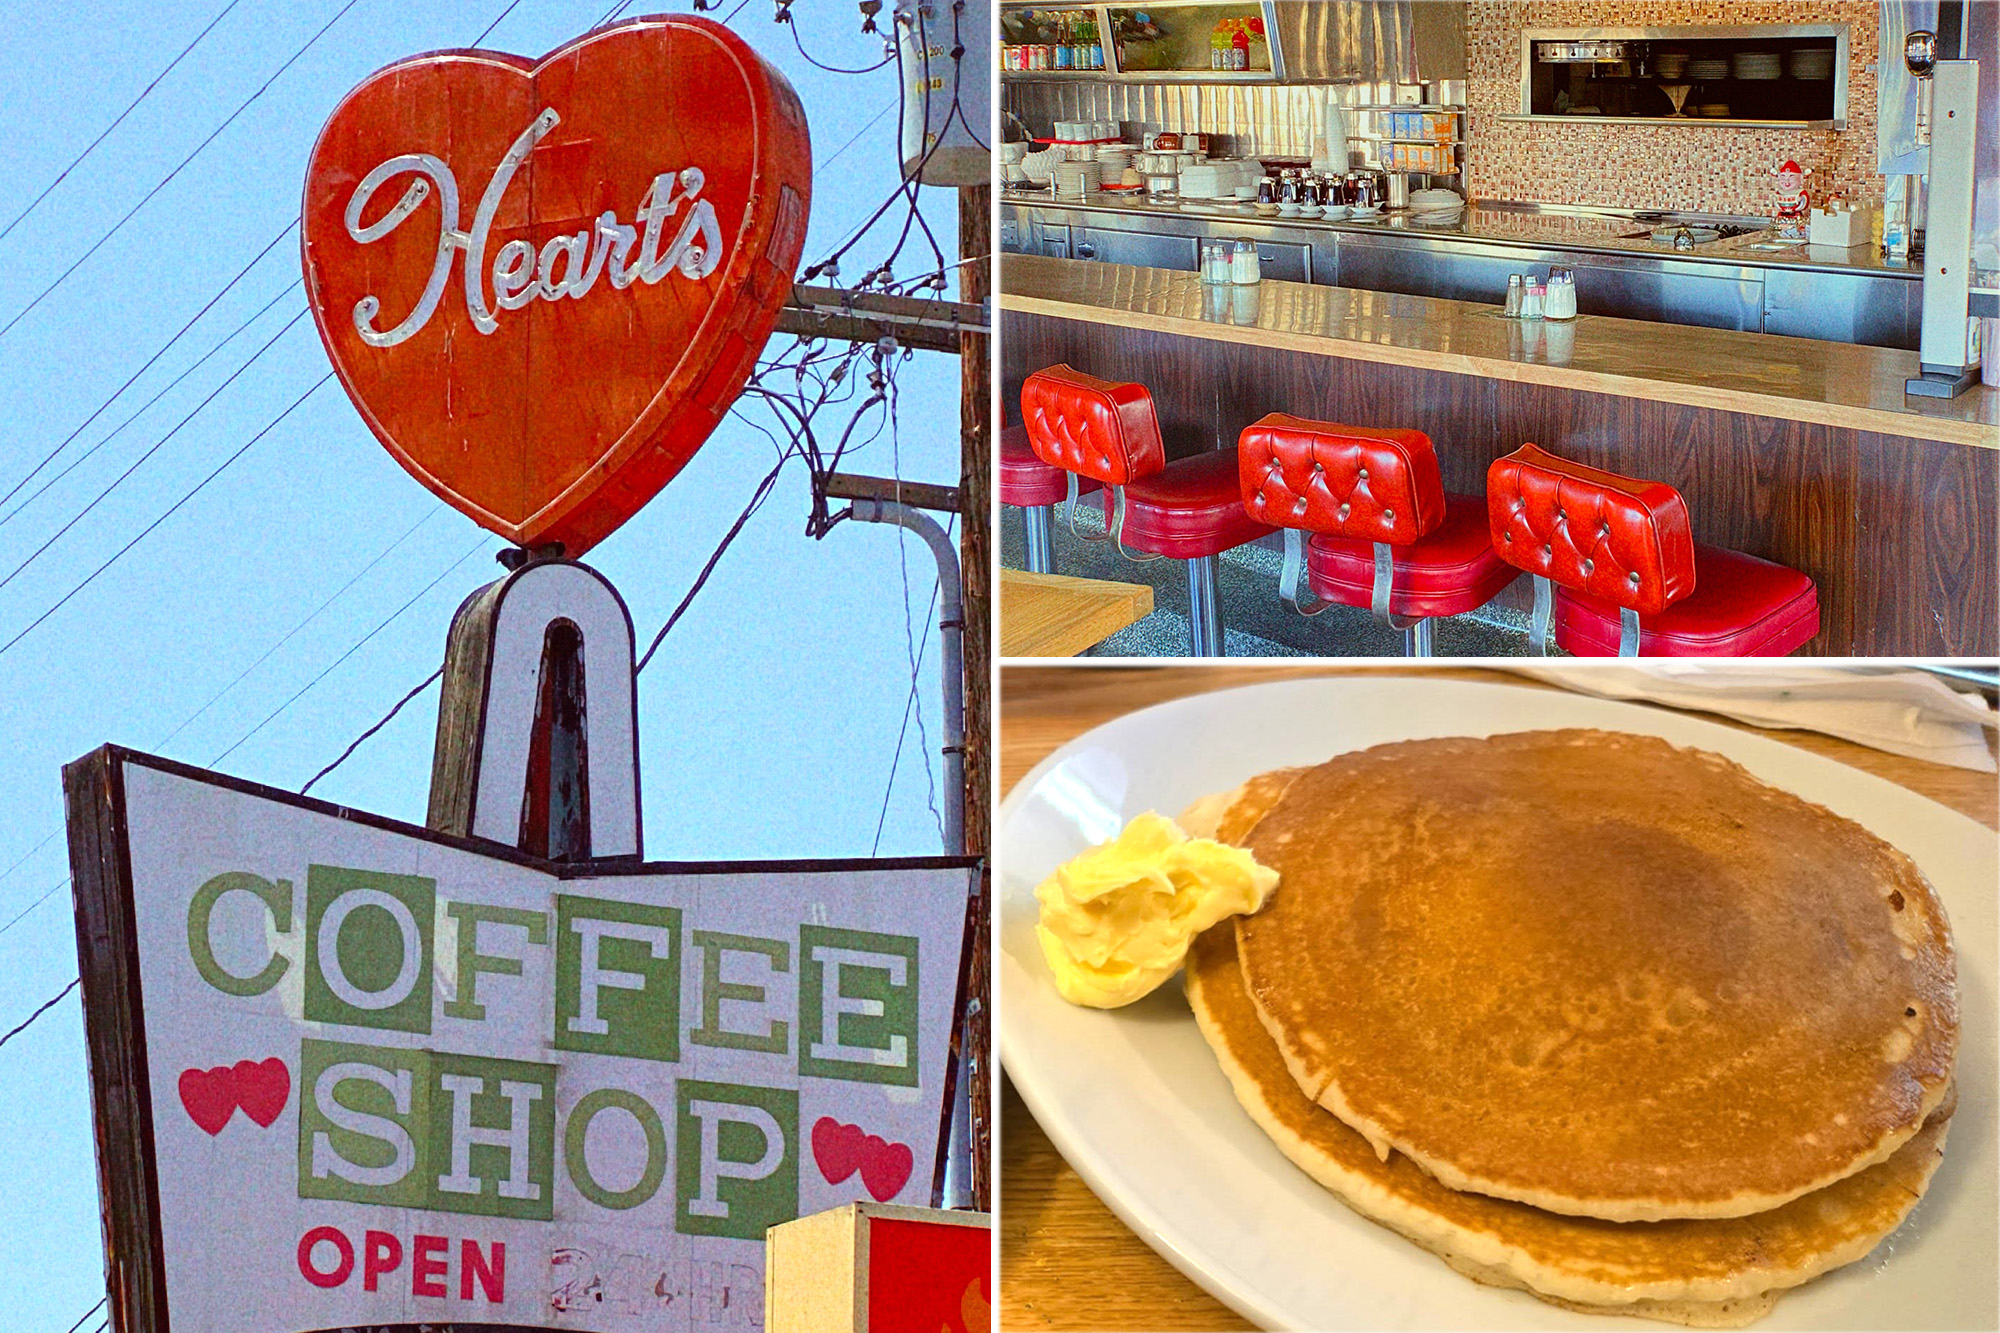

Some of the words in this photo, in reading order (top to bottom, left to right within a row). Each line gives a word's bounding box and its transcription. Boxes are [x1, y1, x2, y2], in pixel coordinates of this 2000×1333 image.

[345, 107, 723, 348] Heart's
[187, 870, 909, 1069] COFFEE
[311, 1062, 785, 1218] SHOP
[298, 1226, 505, 1304] OPEN
